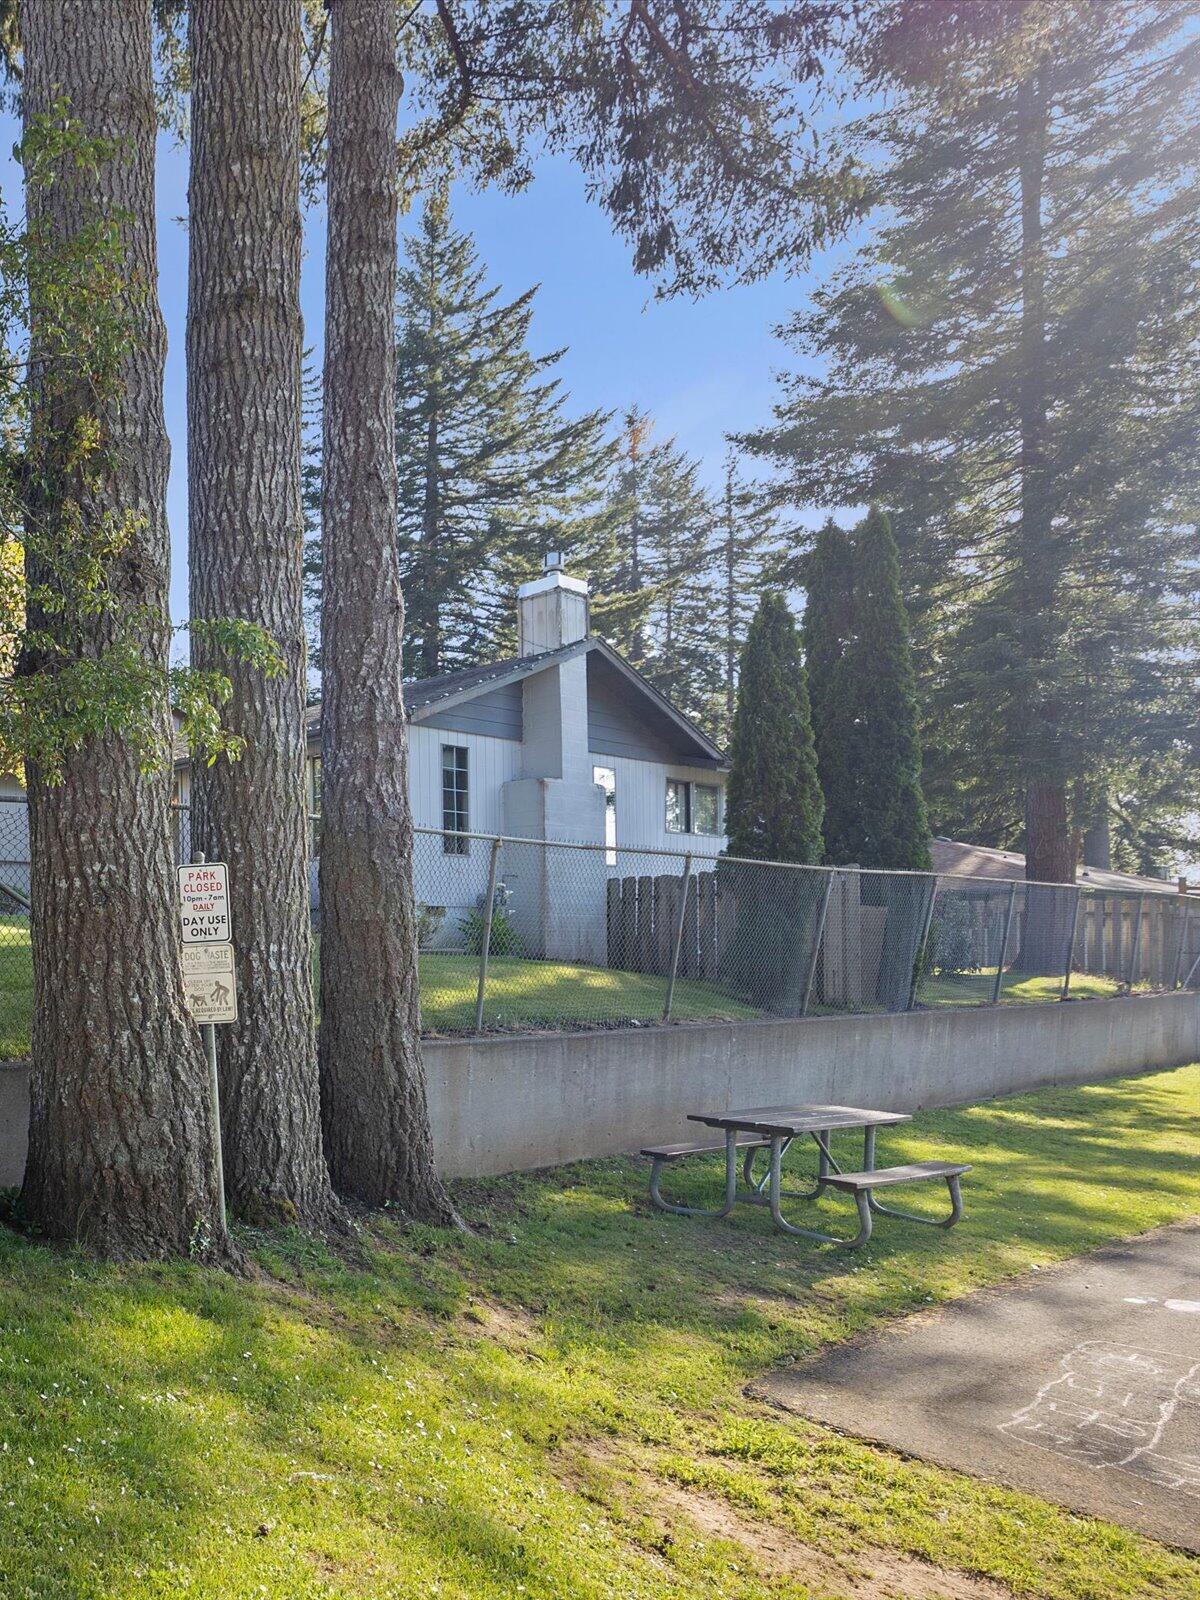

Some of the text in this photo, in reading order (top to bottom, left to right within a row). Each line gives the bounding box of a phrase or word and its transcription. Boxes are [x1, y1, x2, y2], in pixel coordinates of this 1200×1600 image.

[188, 871, 216, 881] PARK
[183, 882, 222, 893] CLOSED
[183, 895, 203, 903] 10pm
[192, 903, 215, 911] DAILY
[183, 915, 226, 926] DAY USE
[191, 926, 219, 937] ONLY
[184, 952, 201, 961] DOG
